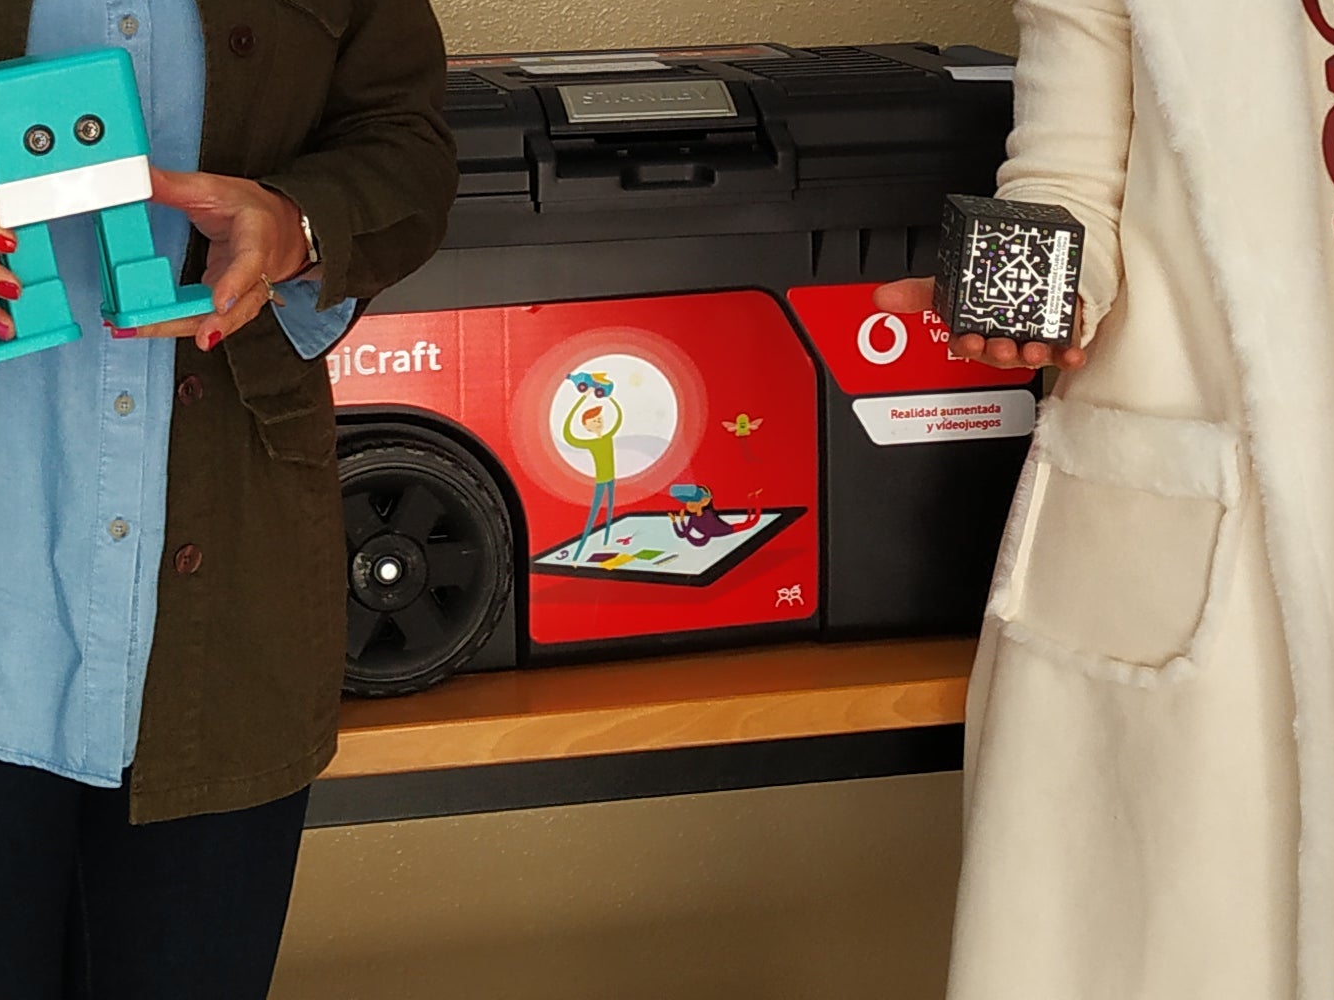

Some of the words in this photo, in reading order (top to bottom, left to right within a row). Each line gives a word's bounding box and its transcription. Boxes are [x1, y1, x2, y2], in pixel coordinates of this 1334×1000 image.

[922, 310, 942, 325] Fu
[929, 328, 950, 343] Vo
[891, 407, 937, 420] Realidad
[940, 403, 1001, 417] aumentada
[927, 422, 934, 434] y
[936, 417, 1002, 432] videojuegos
